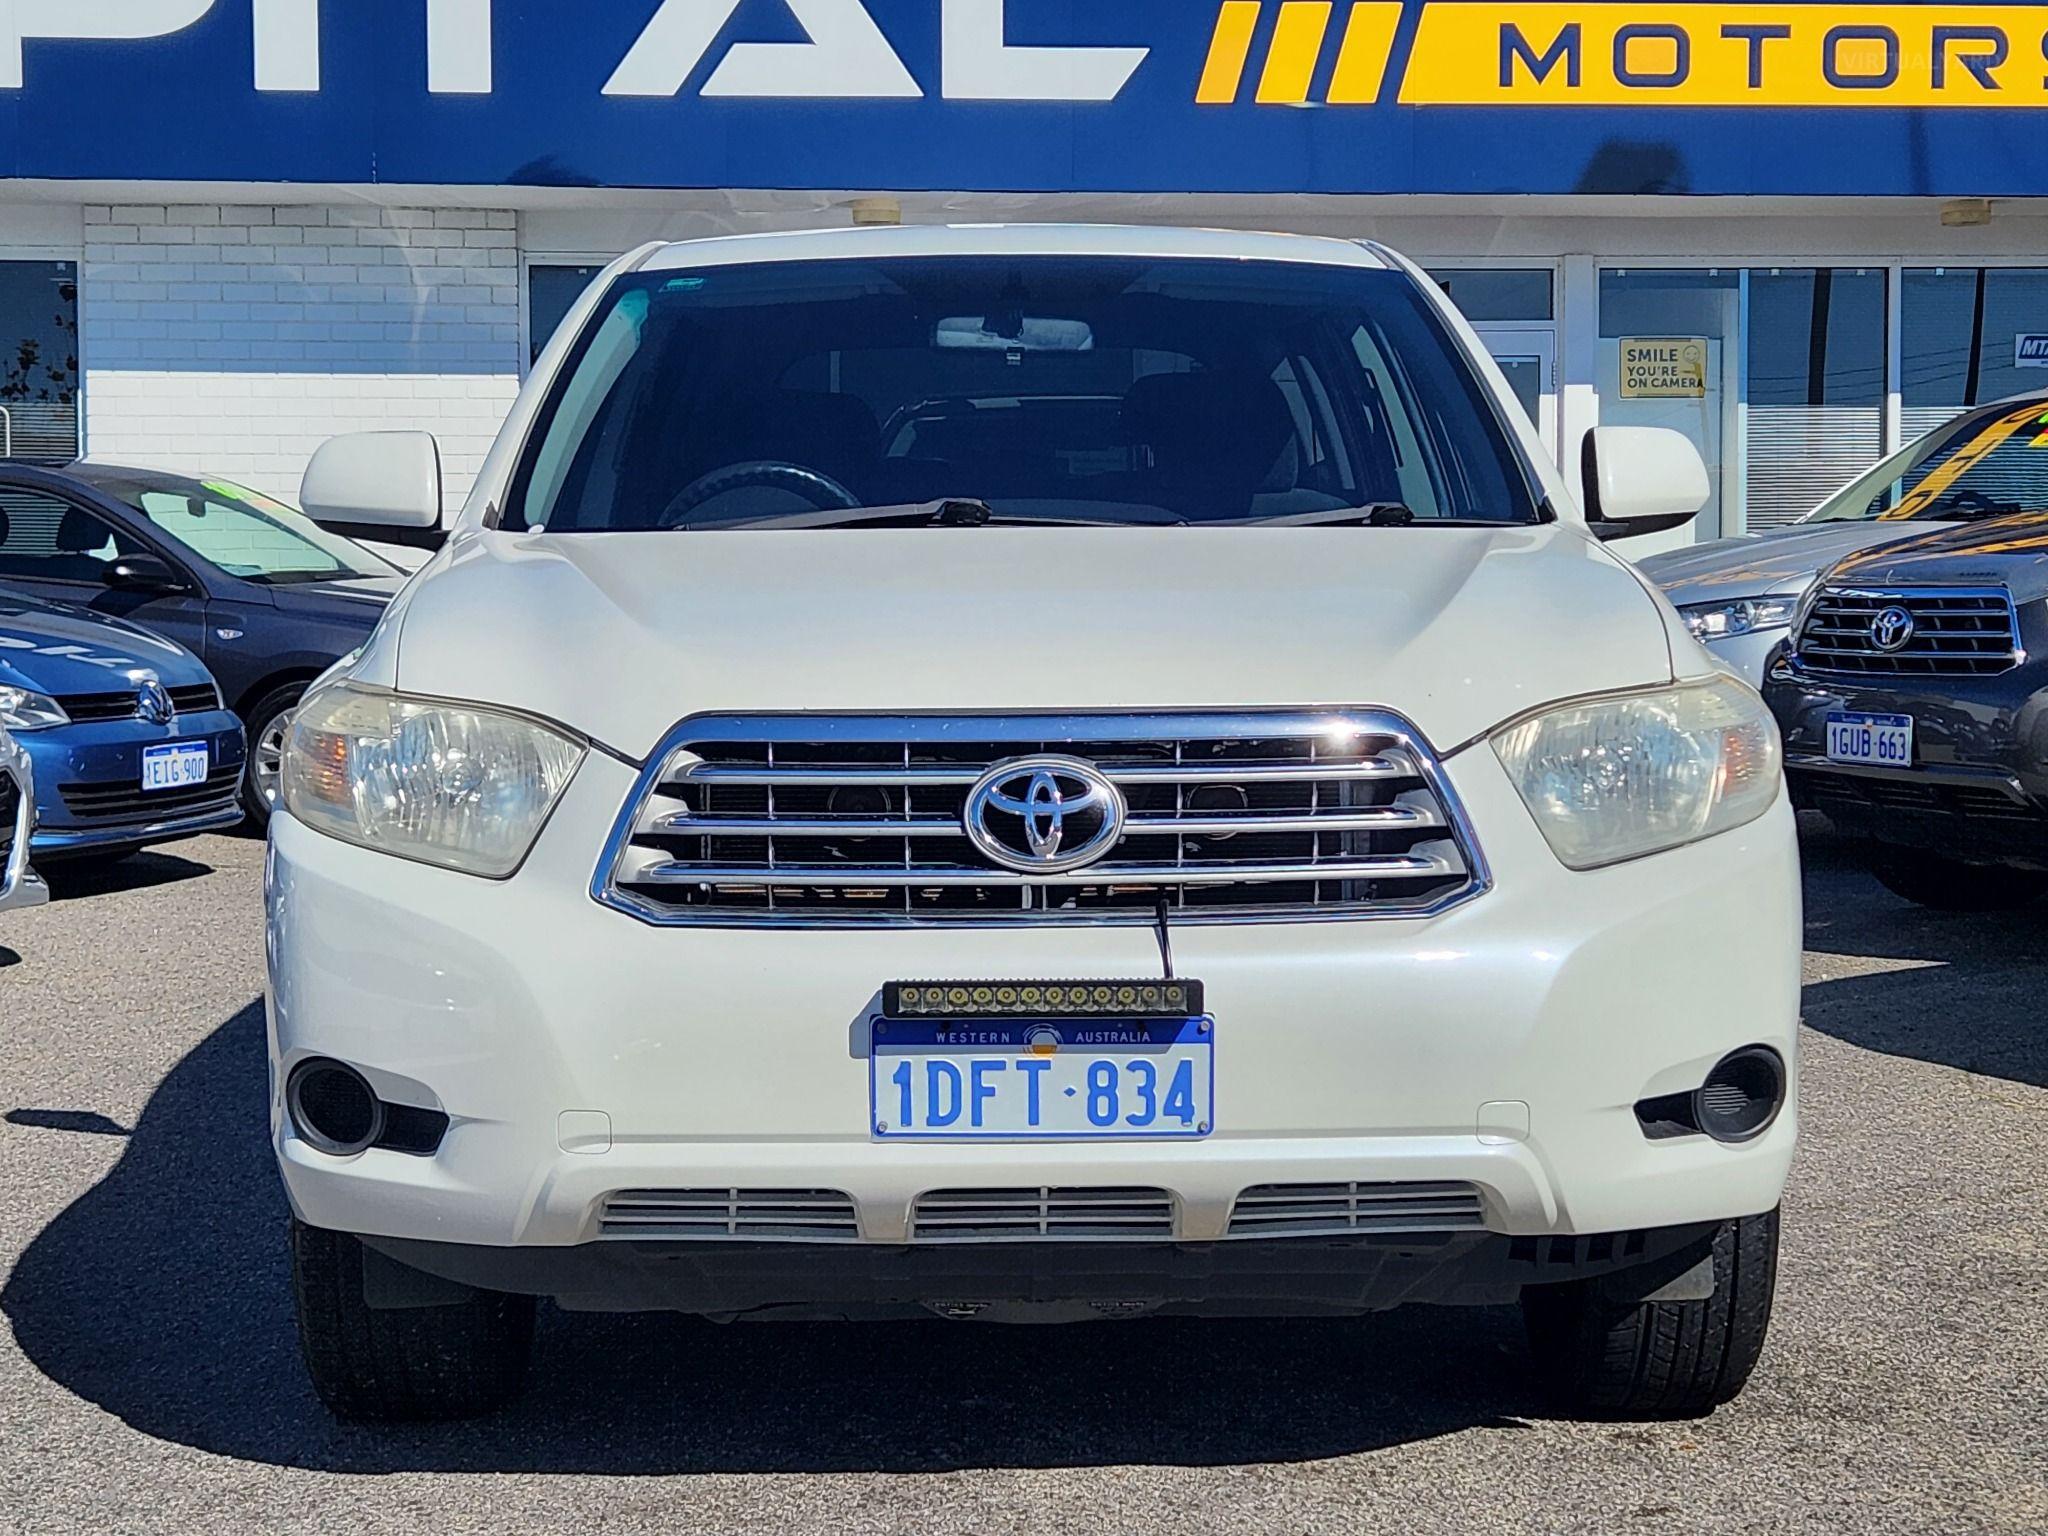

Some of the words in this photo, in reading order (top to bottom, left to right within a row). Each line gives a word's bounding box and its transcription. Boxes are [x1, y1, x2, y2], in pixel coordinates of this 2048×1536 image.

[1498, 23, 2048, 90] MOTOR
[1627, 349, 1678, 362] SMILE
[1627, 366, 1678, 376] YOU'RE
[1627, 378, 1648, 388] ON
[1651, 378, 1704, 388] CAMERA
[936, 1032, 1011, 1043] WESTERN
[1075, 1032, 1151, 1043] AUSTRALIA
